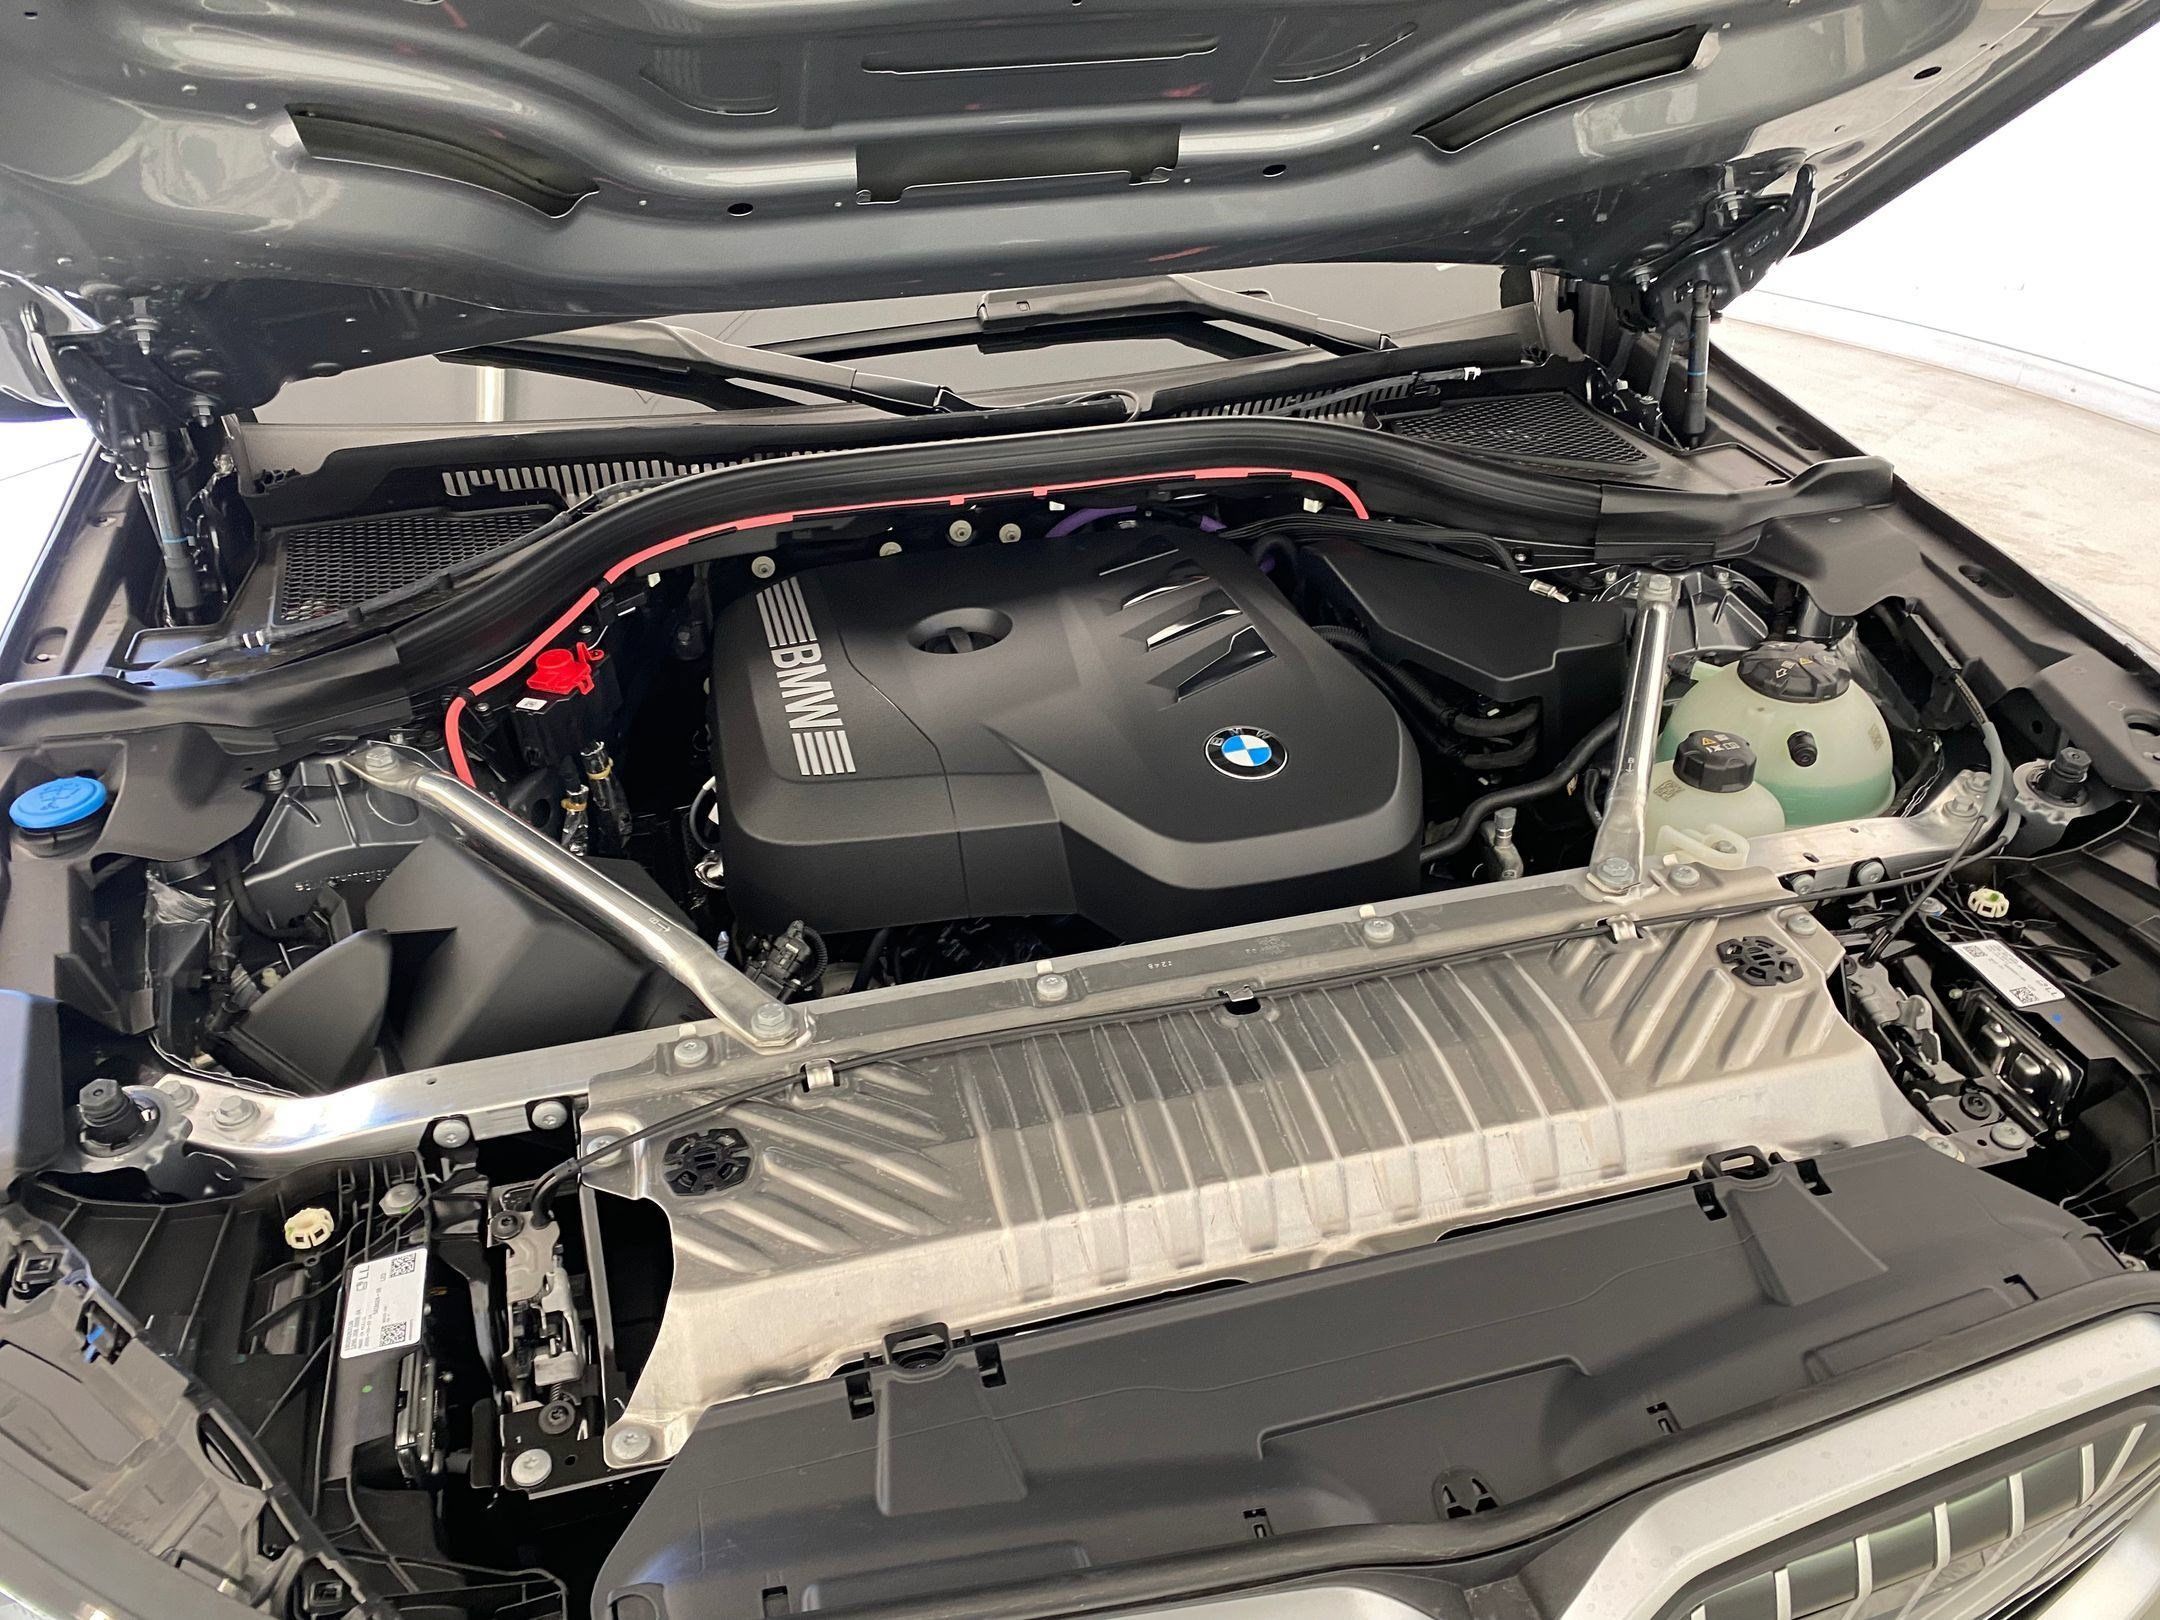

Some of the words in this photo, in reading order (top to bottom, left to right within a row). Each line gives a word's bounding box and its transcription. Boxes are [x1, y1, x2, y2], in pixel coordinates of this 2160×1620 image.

[770, 642, 844, 729] BMW
[1210, 728, 1271, 747] BMW
[358, 1265, 370, 1281] LL
